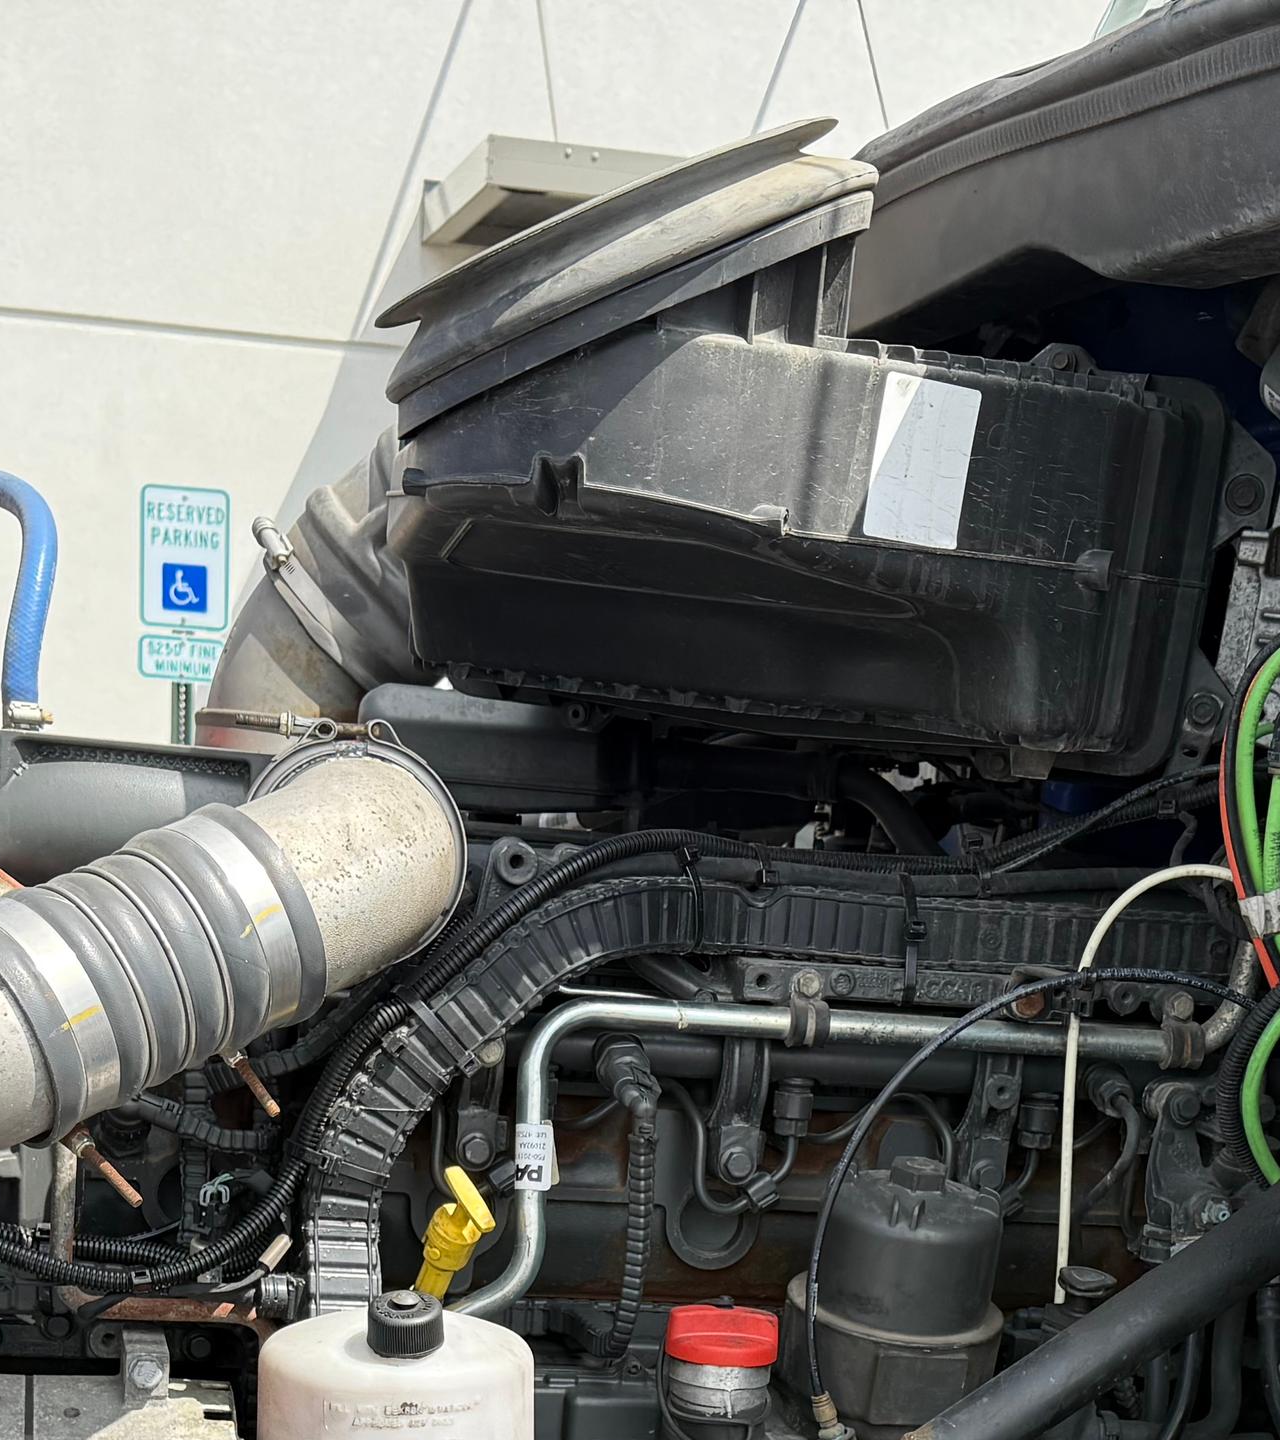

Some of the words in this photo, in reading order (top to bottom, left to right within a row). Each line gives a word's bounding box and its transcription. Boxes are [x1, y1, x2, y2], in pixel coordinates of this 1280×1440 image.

[147, 501, 225, 525] RESERVED
[151, 527, 220, 550] PARKING
[155, 661, 211, 676] MINIMUM
